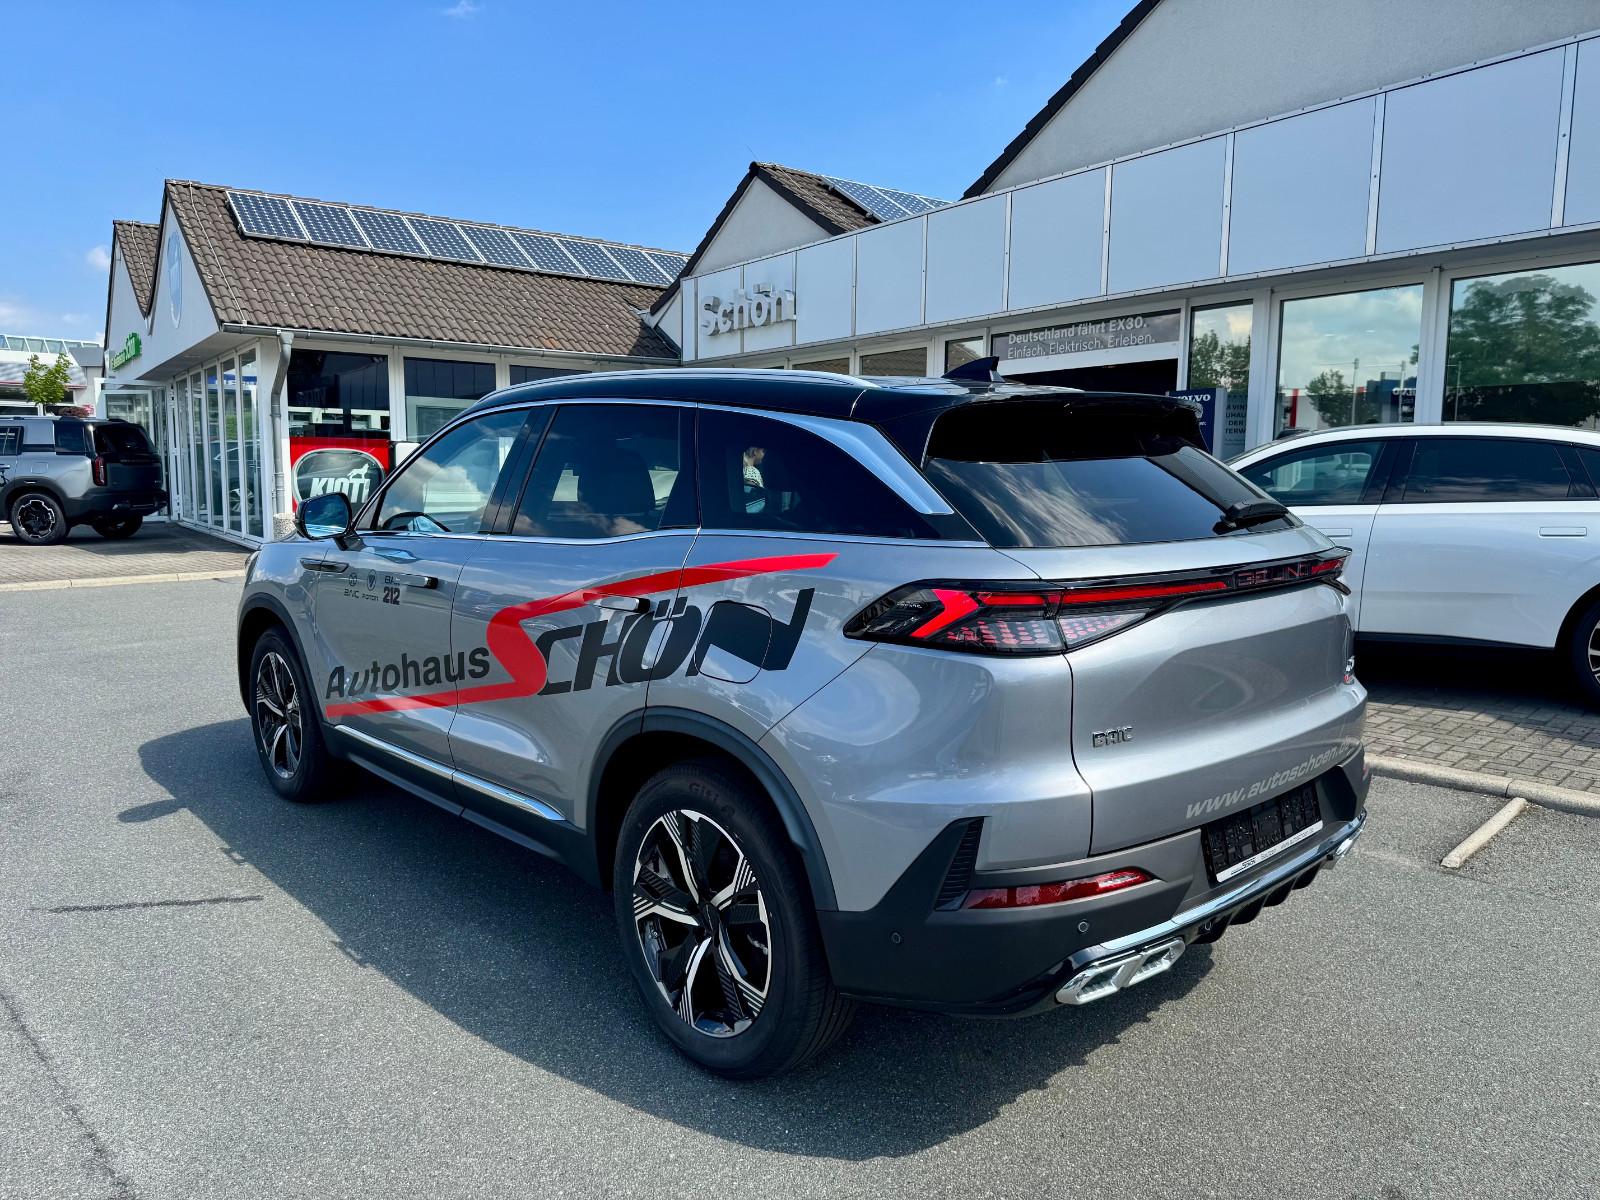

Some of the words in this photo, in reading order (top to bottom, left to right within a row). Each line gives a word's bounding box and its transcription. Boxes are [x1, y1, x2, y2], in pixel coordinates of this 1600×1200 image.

[700, 283, 796, 336] Schön
[1008, 327, 1074, 345] Deutschland
[1078, 322, 1105, 337] fährt
[1109, 315, 1147, 332] EX30.
[1007, 346, 1046, 360] Einfach.
[1049, 337, 1104, 355] Elektrisch.
[1107, 333, 1156, 348] Erleben.
[1177, 394, 1211, 403] OLVO
[382, 586, 400, 605] 212
[325, 646, 490, 699] Autohaus
[1091, 726, 1134, 748] BAIC
